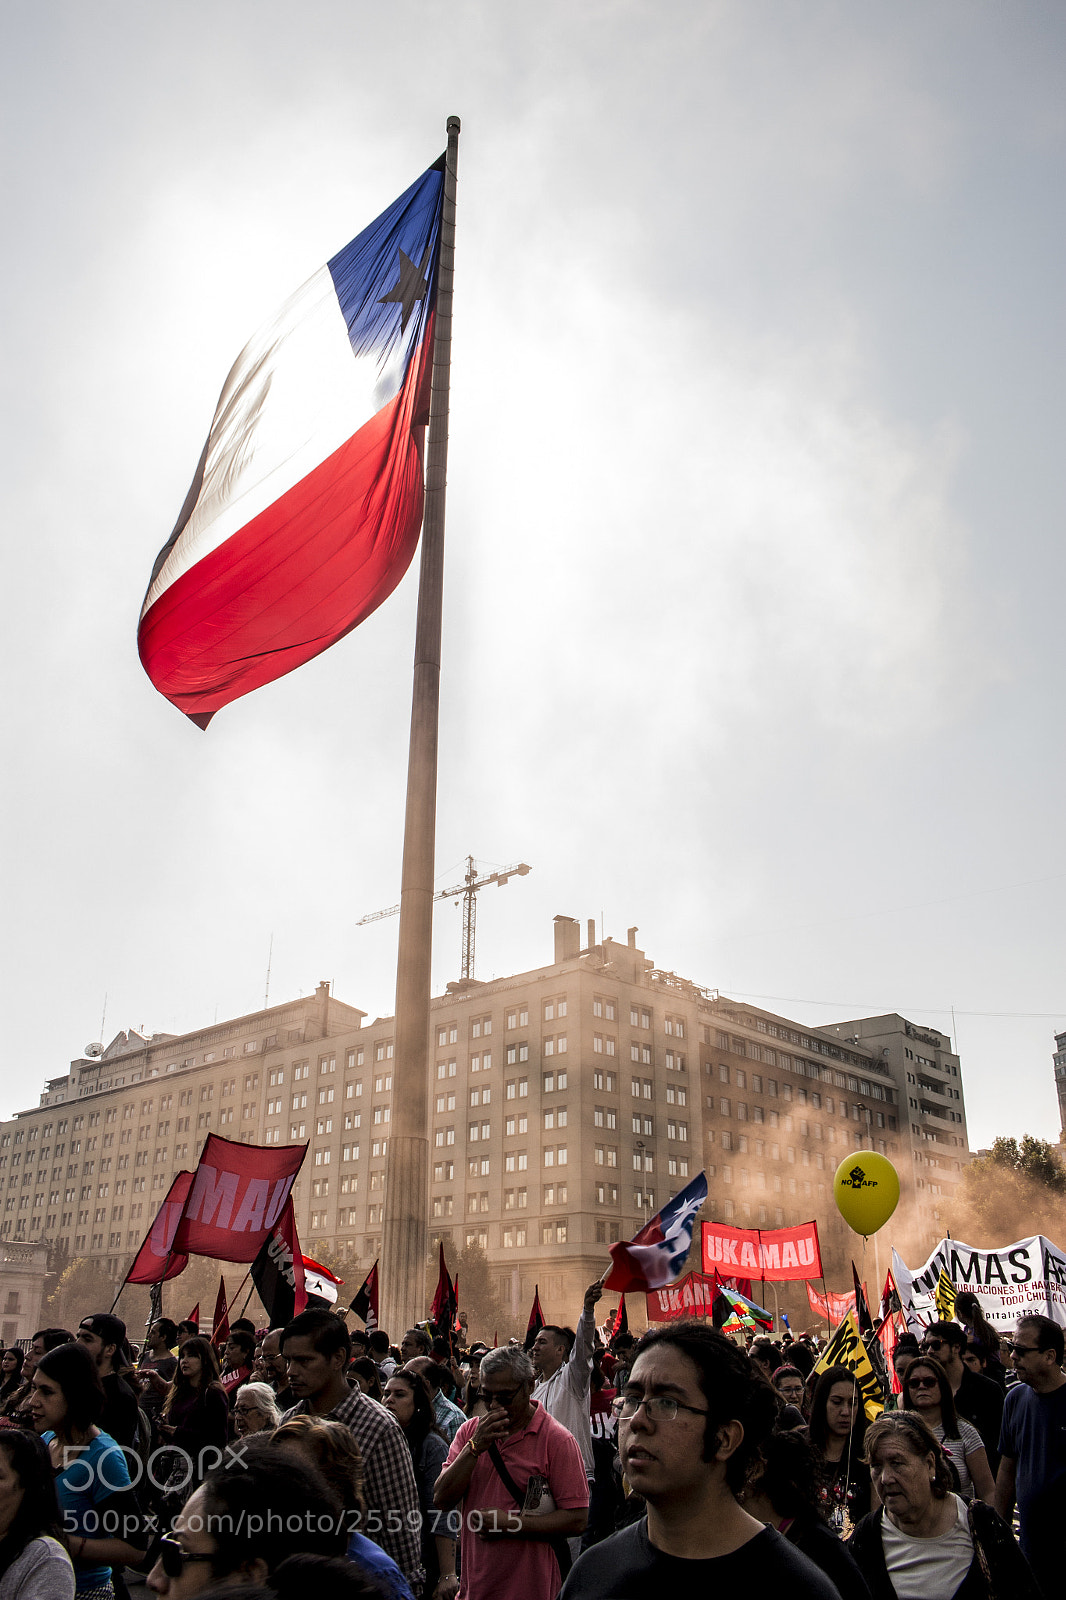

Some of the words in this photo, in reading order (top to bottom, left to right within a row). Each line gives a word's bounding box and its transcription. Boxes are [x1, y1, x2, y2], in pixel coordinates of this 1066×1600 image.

[185, 1163, 295, 1232] MAU
[268, 1233, 296, 1292] UKA
[707, 1234, 815, 1269] UKAMAU
[951, 1248, 1032, 1285] MAS
[1000, 1294, 1024, 1306] TODO
[1026, 1291, 1051, 1302] CHILE
[1052, 1293, 1058, 1302] A
[1018, 1283, 1029, 1293] DE
[985, 1308, 1040, 1320] pitalistas
[221, 1369, 240, 1384] MAU
[590, 1412, 618, 1439] UK
